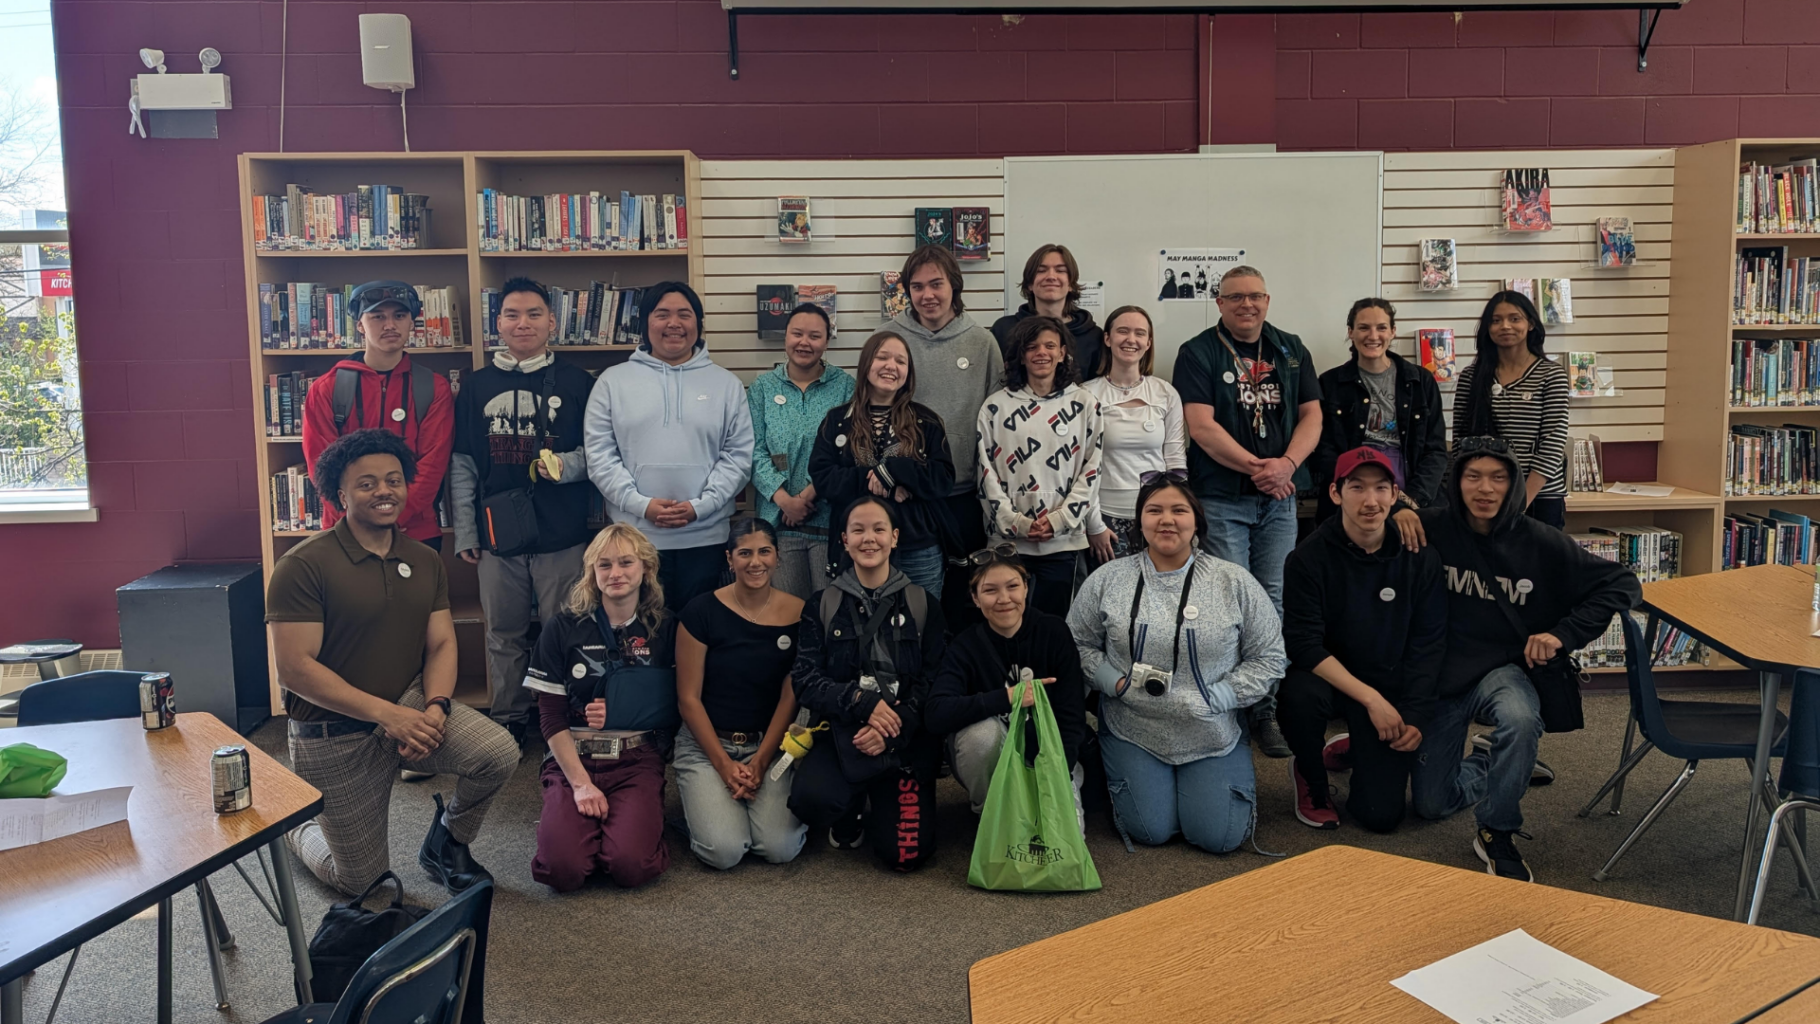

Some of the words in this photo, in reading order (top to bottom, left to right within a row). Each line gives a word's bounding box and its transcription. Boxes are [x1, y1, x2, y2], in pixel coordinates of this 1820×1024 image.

[1506, 168, 1550, 189] AKIRA
[760, 302, 793, 311] UZUMAKI
[1237, 389, 1281, 405] IONS
[1047, 400, 1084, 434] FILA
[1006, 437, 1041, 474] FILA
[1045, 435, 1080, 471] FILA
[897, 779, 920, 862] THINGS
